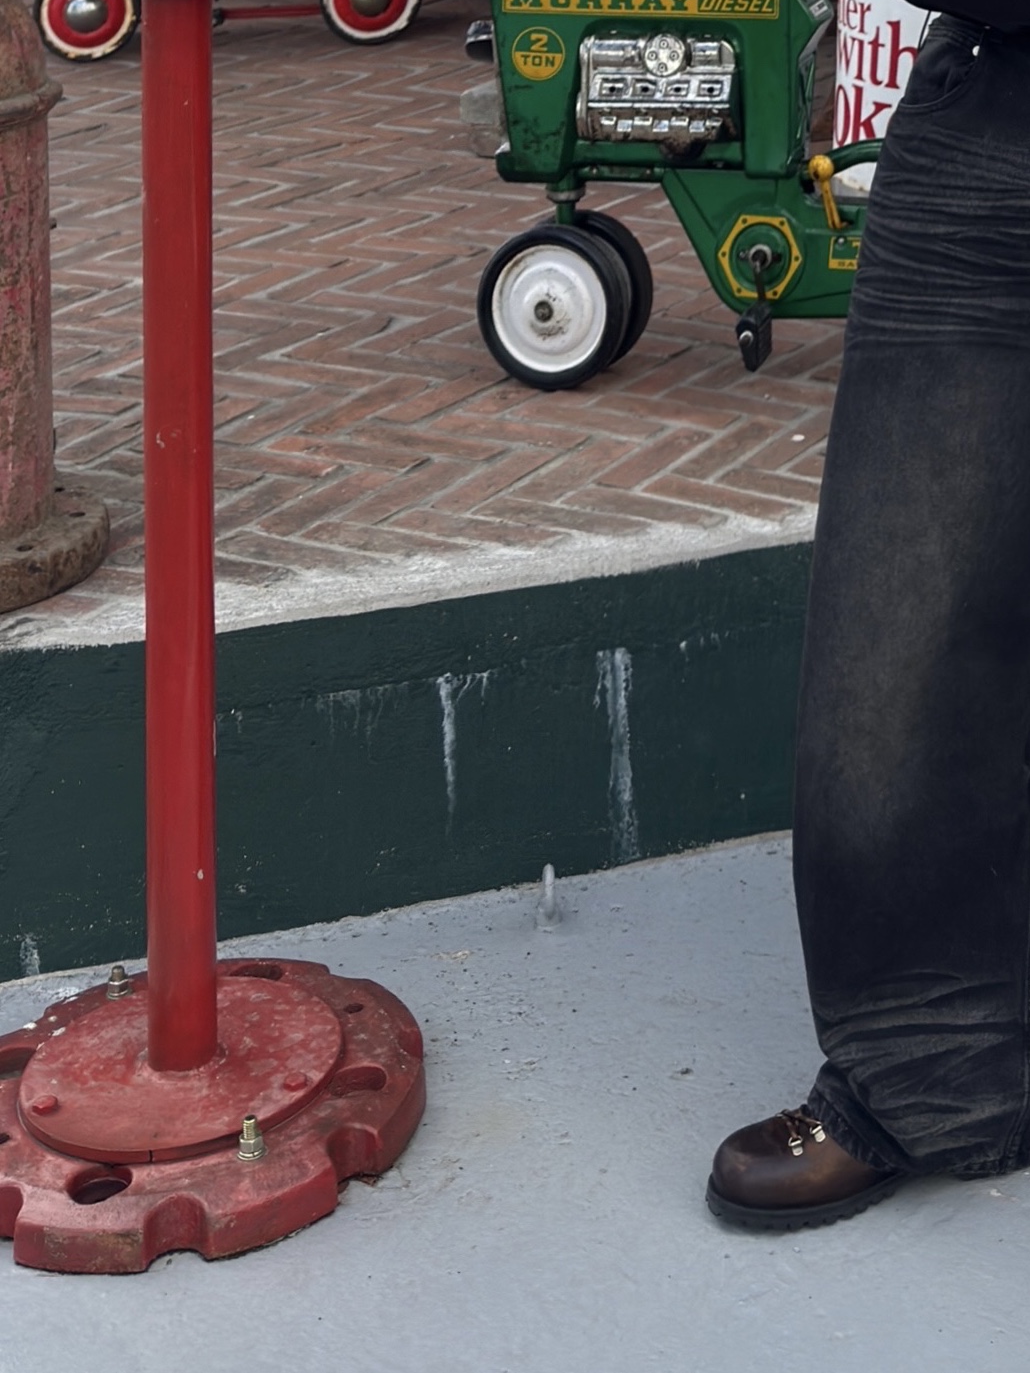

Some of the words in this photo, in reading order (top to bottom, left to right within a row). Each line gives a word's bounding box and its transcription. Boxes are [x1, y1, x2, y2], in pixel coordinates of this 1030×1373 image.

[530, 33, 549, 52] 2
[520, 54, 556, 68] TON
[838, 19, 919, 89] with
